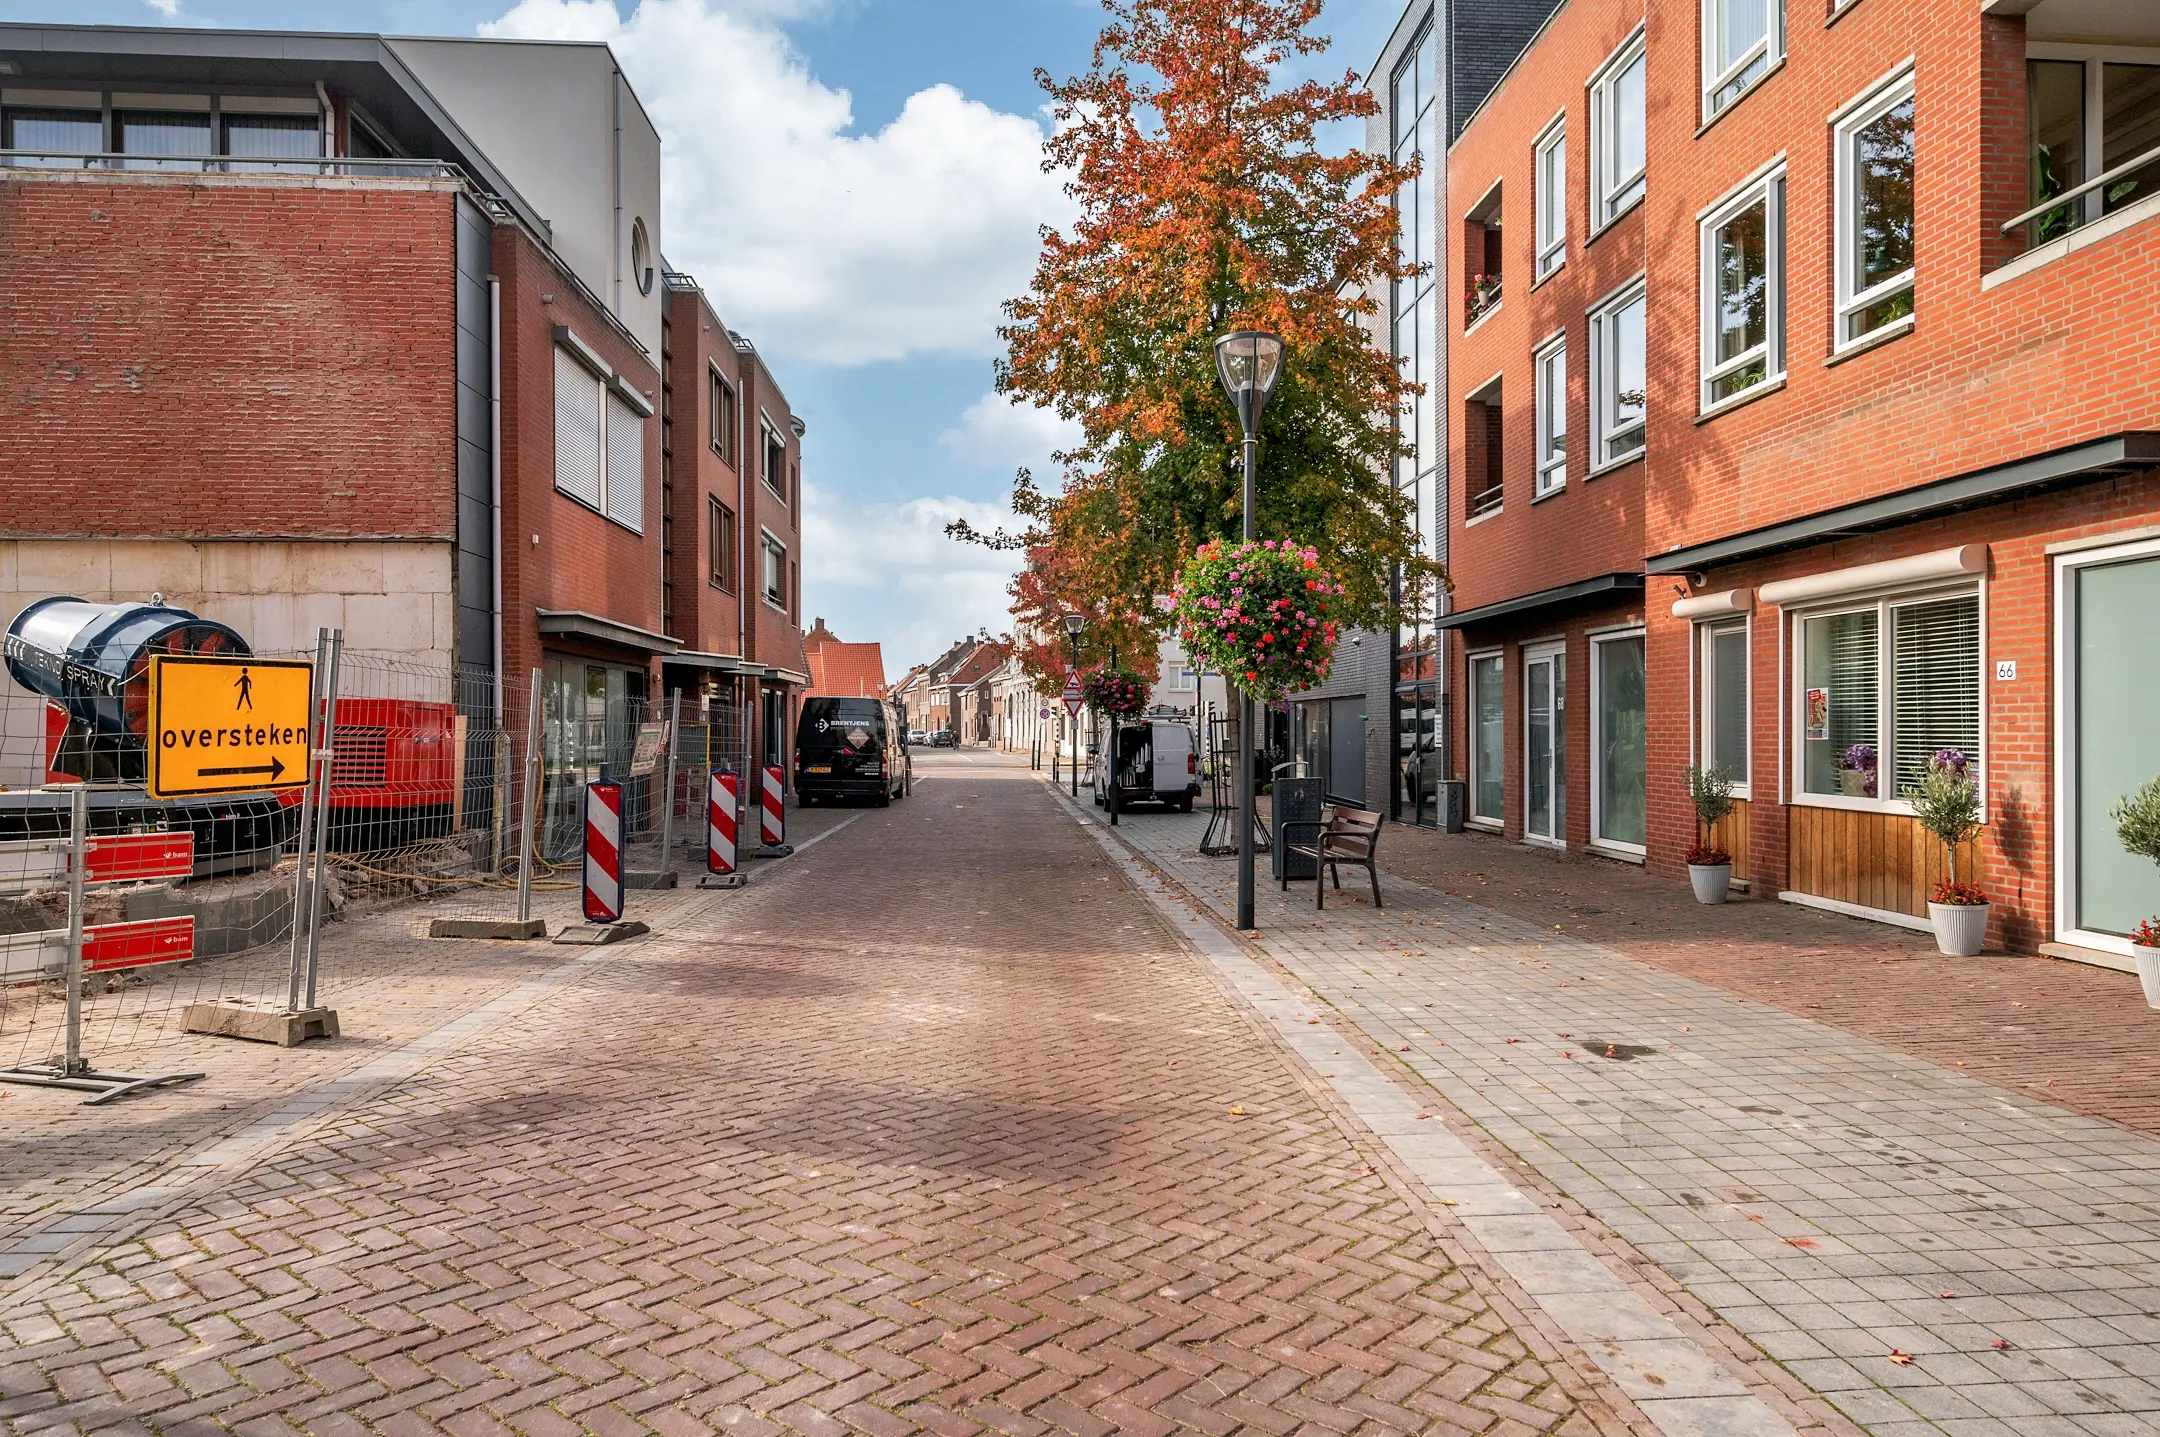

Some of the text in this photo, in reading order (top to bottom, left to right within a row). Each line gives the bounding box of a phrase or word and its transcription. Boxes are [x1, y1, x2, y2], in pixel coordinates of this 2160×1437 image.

[66, 665, 105, 691] SPRAY
[1999, 664, 2013, 678] 66
[162, 722, 307, 748] oversteken
